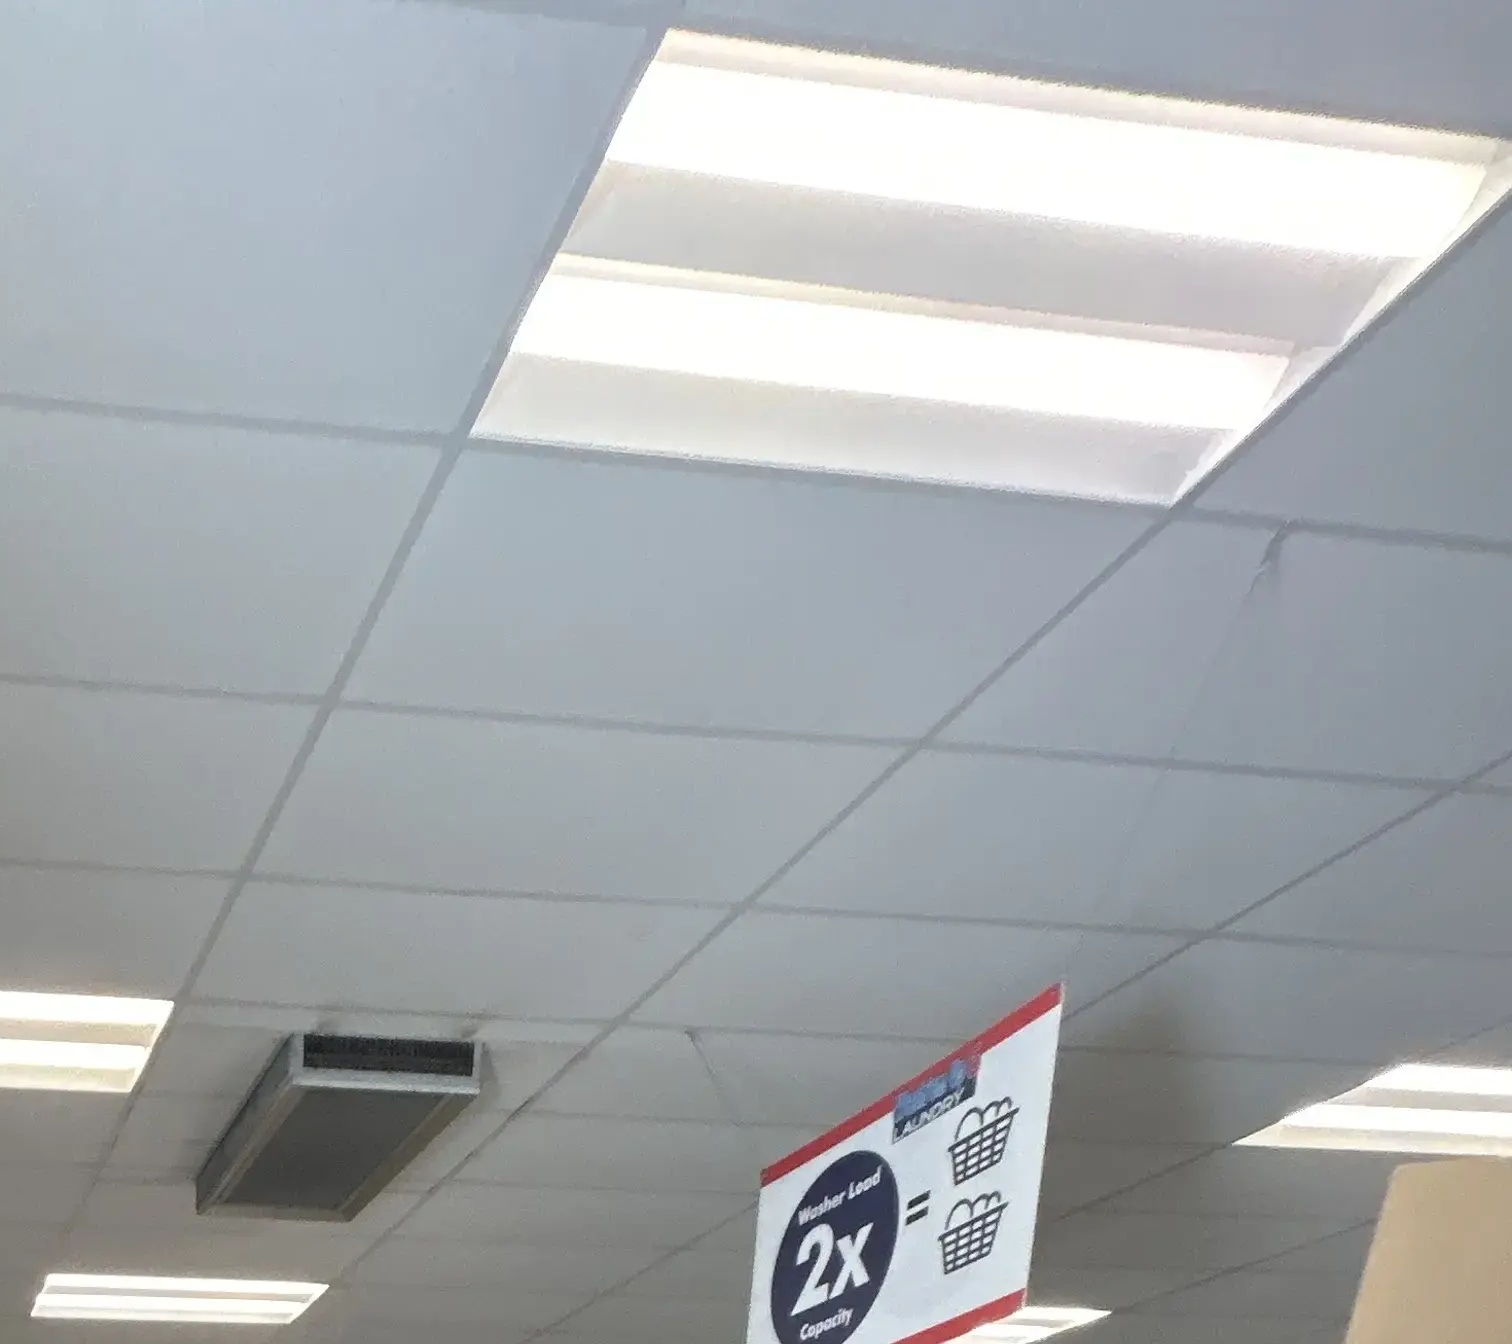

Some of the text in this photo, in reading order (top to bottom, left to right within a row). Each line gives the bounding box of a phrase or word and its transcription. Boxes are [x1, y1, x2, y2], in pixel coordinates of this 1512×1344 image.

[798, 1164, 883, 1227] Washer Load
[800, 1307, 854, 1341] Capacity
